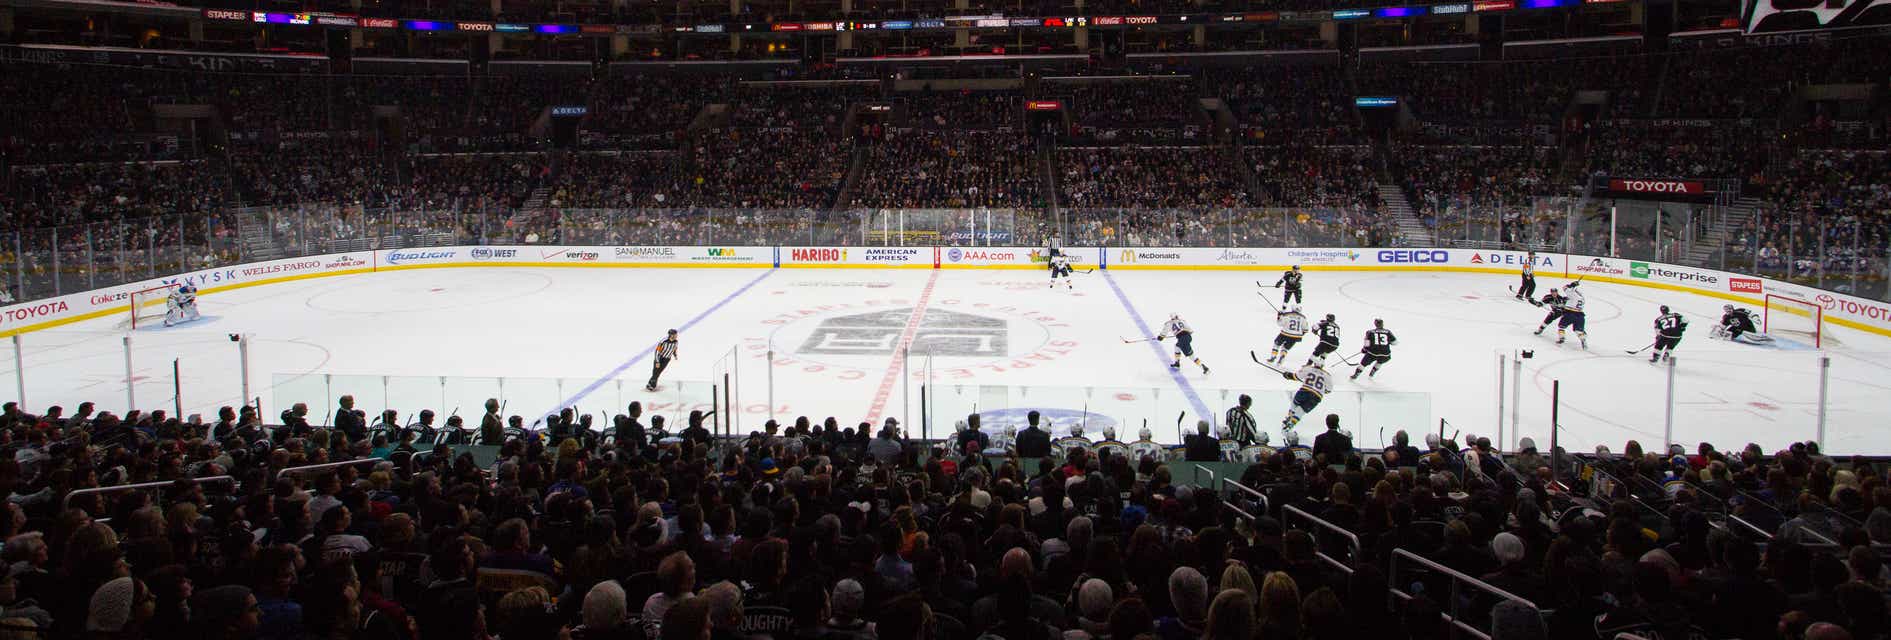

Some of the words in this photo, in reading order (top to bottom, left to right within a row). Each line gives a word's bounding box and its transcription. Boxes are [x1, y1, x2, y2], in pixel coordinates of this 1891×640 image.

[208, 10, 245, 20] STAPLES
[1125, 16, 1157, 24] TOYOTA
[458, 23, 493, 31] TOYOTA
[1623, 180, 1688, 193] TOYOTA
[390, 252, 419, 261] BUD
[420, 251, 456, 259] LIGHT
[494, 249, 517, 258] WEST
[566, 250, 599, 261] verizon
[616, 247, 634, 256] SAN
[640, 247, 675, 256] MANUEL
[792, 248, 840, 262] HARIBO
[964, 251, 1015, 261] AAA.com
[1138, 252, 1180, 260] McDonald's
[1320, 251, 1348, 259] Hospital
[1377, 250, 1449, 263] GEICO
[1490, 253, 1553, 266] DELTA
[242, 266, 281, 277] WELLS
[283, 261, 321, 272] FARGO
[1731, 281, 1761, 290] STAPLES
[5, 301, 68, 322] TOYOTA
[1289, 319, 1300, 332] 21
[1660, 317, 1676, 330] 27
[1374, 333, 1388, 346] 13
[1305, 372, 1325, 390] 26
